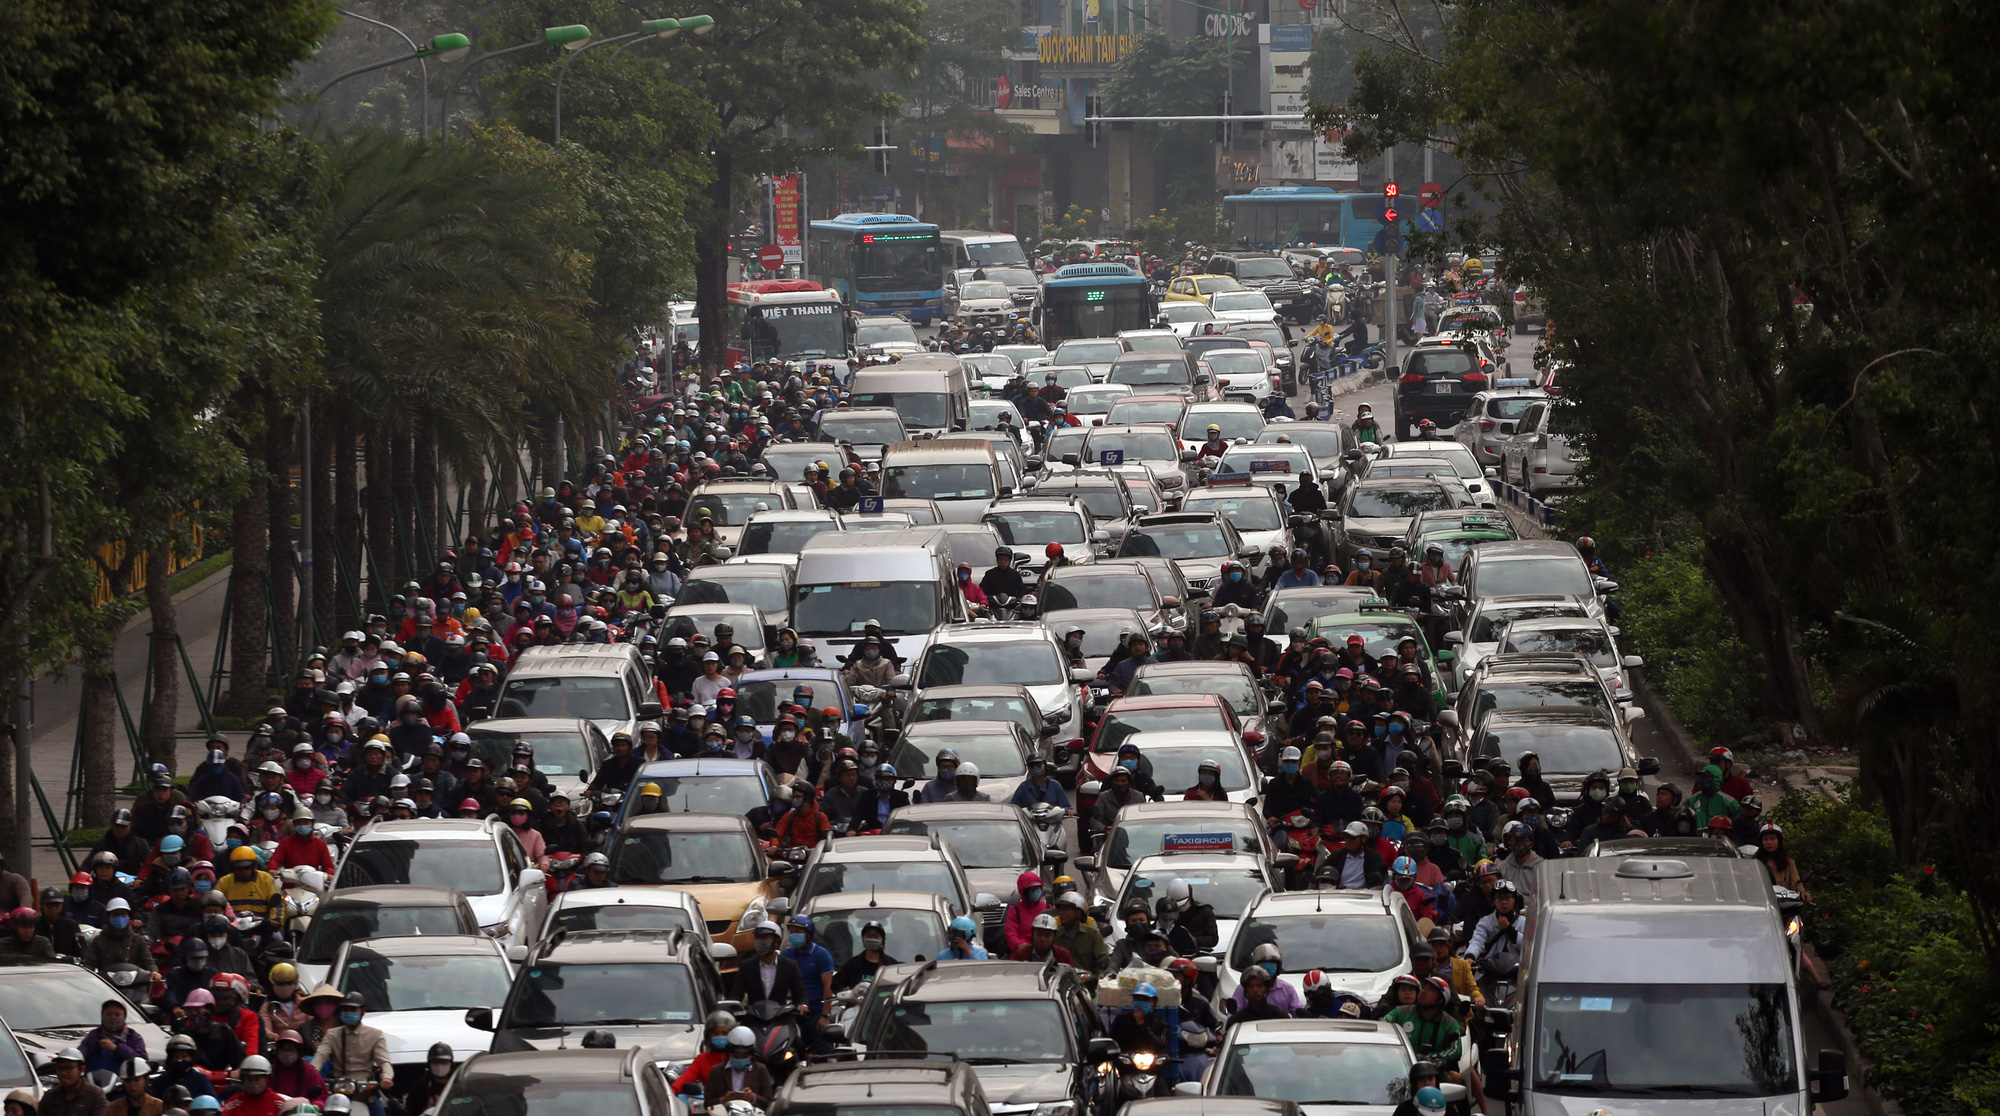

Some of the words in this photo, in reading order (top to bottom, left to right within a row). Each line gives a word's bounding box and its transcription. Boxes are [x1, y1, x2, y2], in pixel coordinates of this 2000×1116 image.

[1014, 84, 1031, 98] Sales
[1032, 84, 1055, 98] Centre
[791, 305, 833, 316] THANH
[1106, 451, 1118, 463] G7
[864, 498, 878, 511] G7
